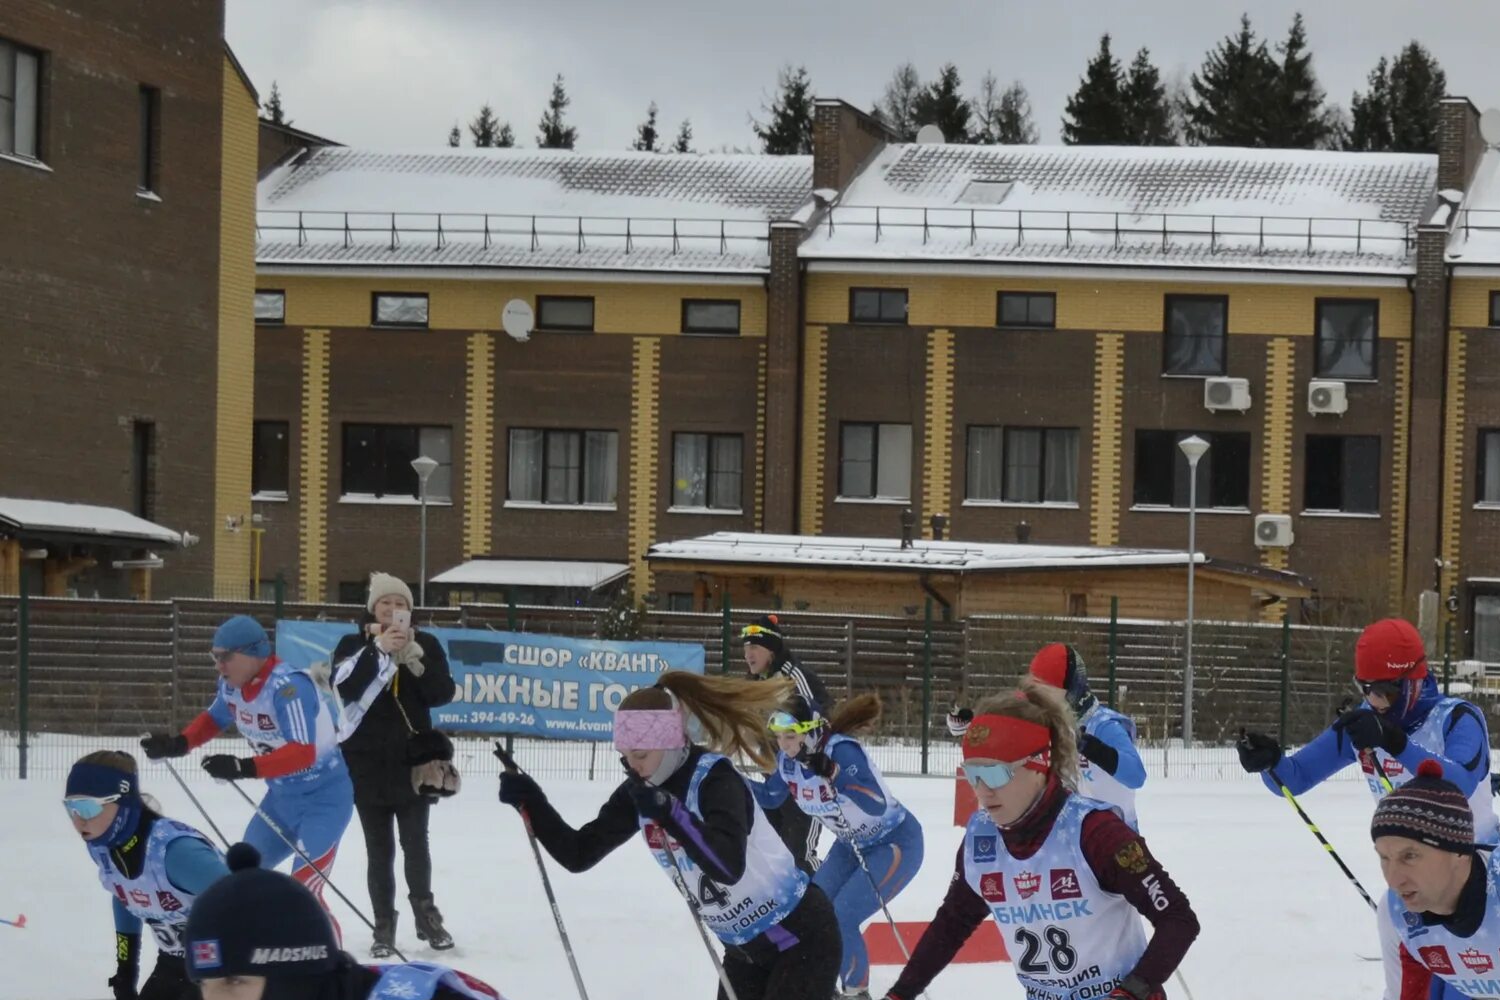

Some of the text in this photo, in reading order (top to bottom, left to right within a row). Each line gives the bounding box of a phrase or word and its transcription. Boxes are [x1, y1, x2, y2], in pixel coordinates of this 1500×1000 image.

[503, 644, 669, 673] СШОР «КВАНТ»
[451, 673, 578, 710] ЫЖНЫЕ
[438, 713, 468, 724] тел.:
[470, 711, 536, 726] 394-49-26
[731, 897, 780, 934] ГОНОК
[991, 899, 1093, 924] БНИНСК
[250, 945, 328, 965] MADSHUS
[1014, 924, 1078, 974] 28
